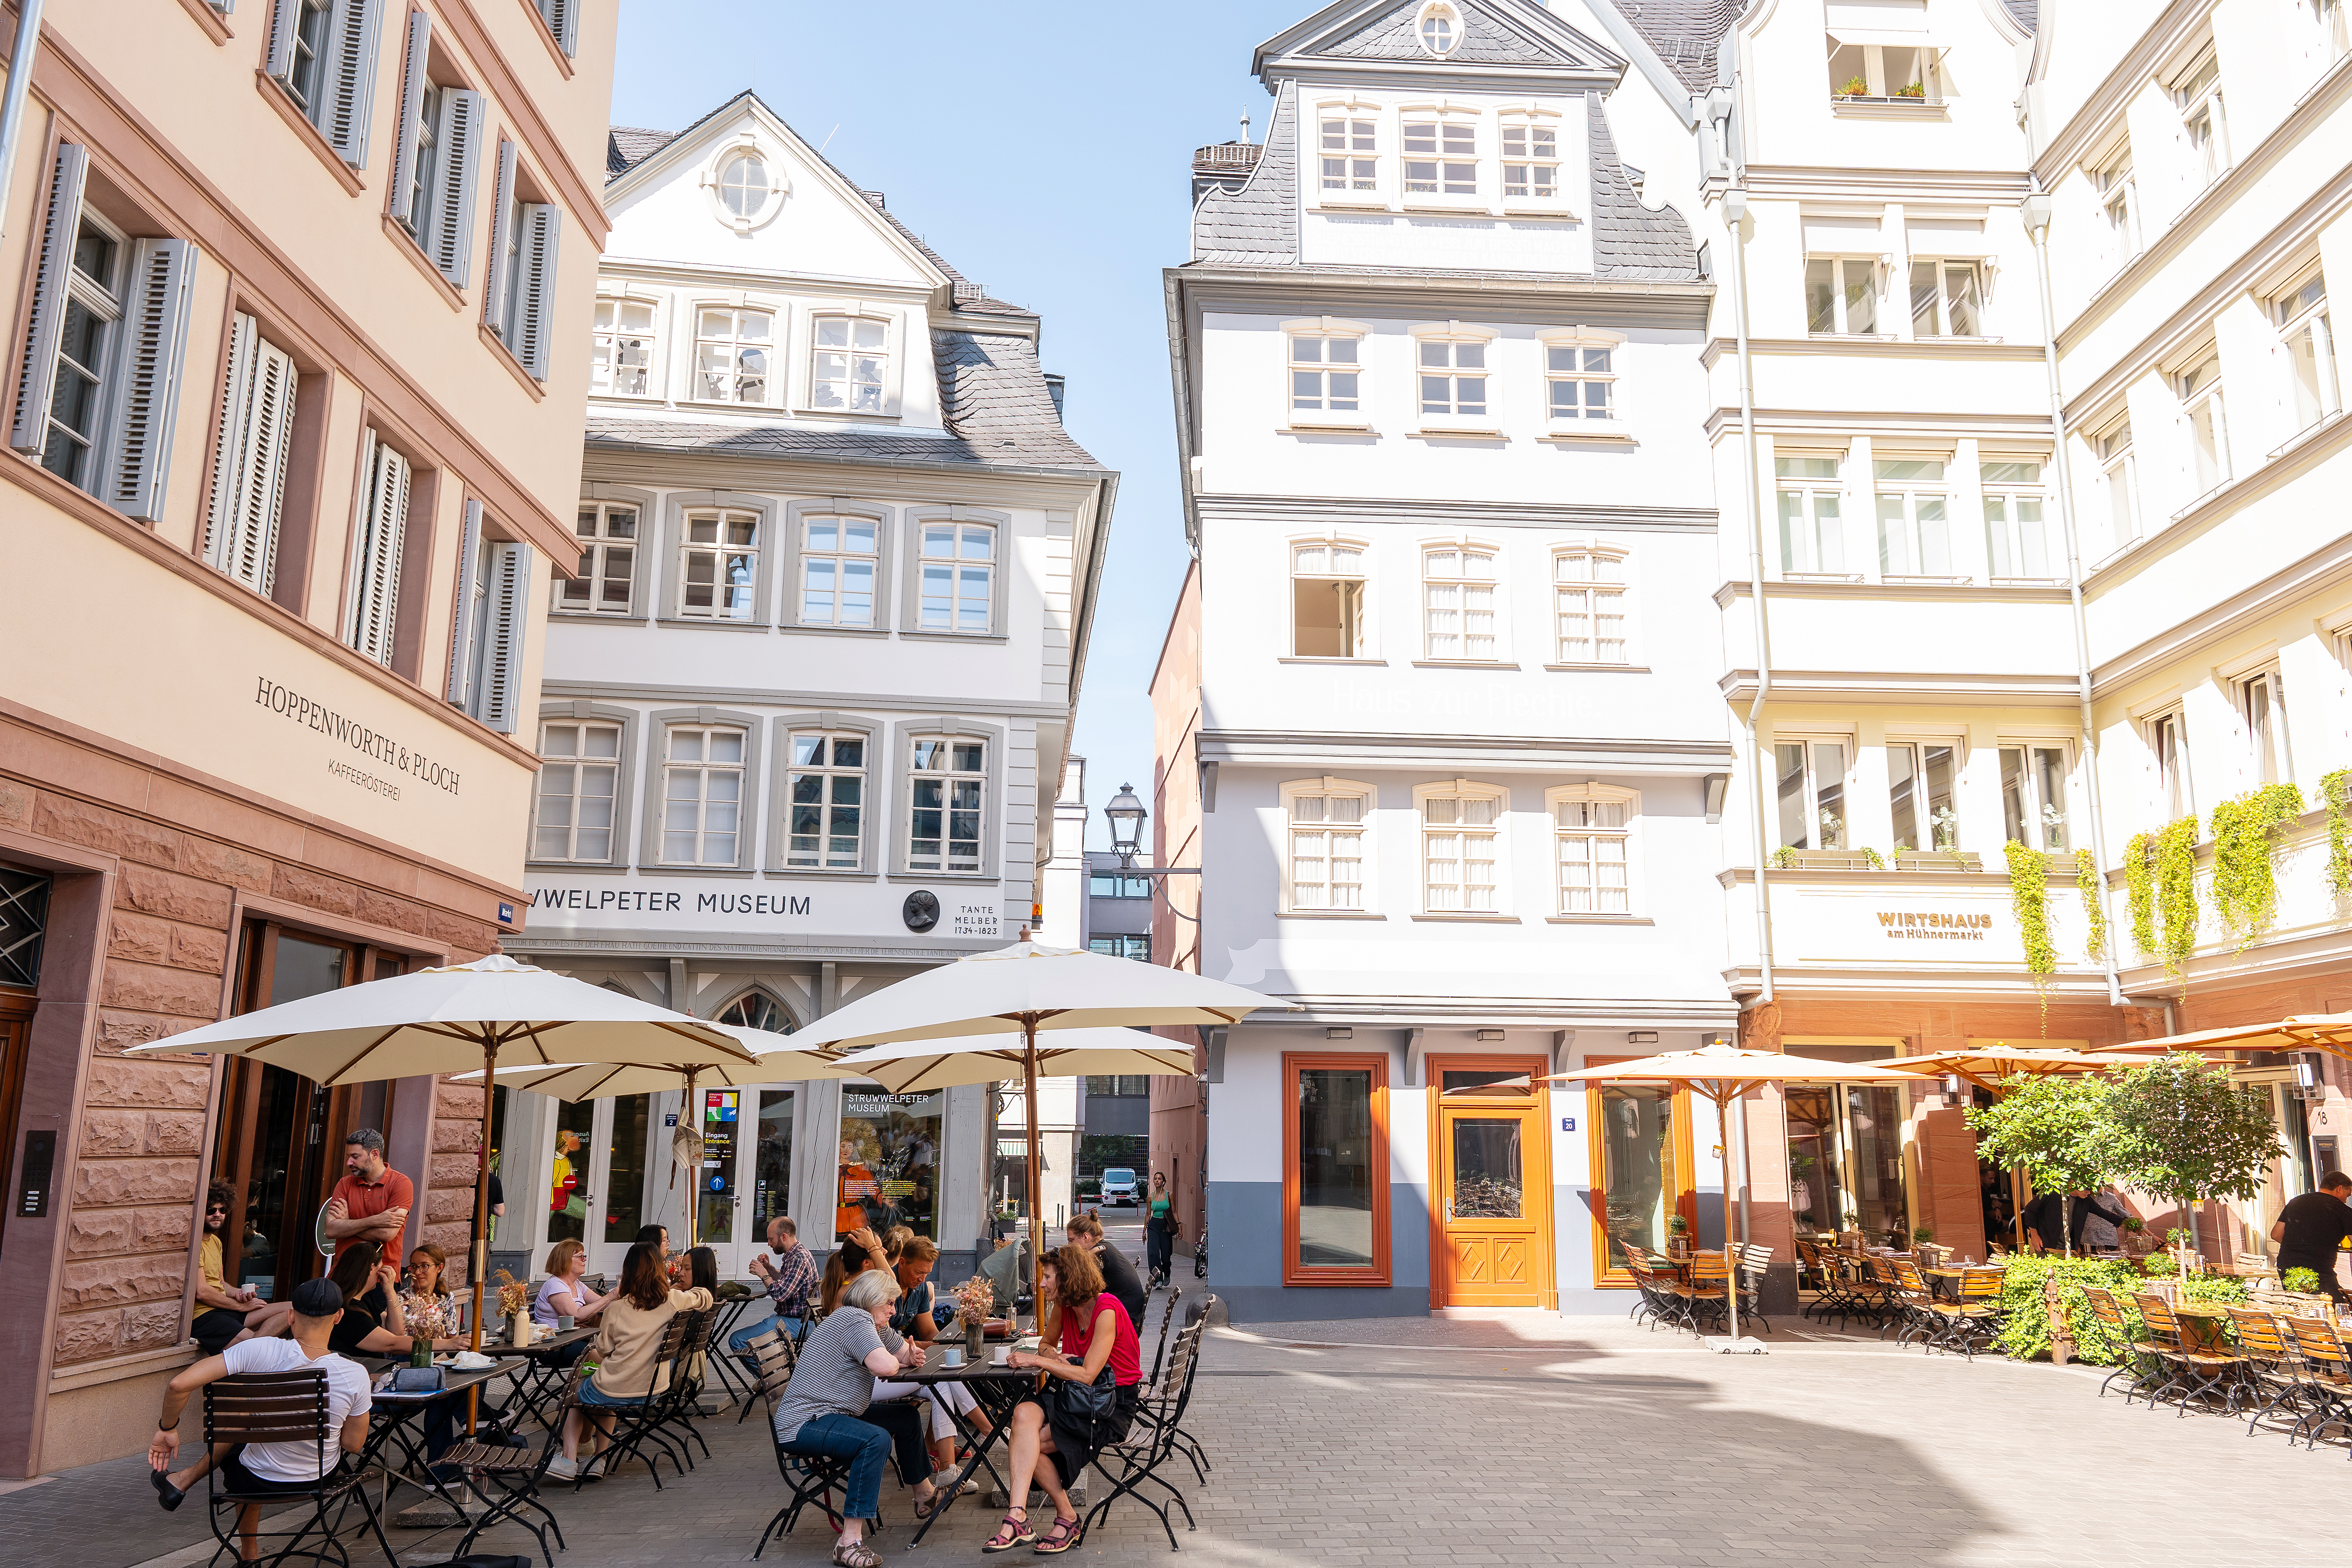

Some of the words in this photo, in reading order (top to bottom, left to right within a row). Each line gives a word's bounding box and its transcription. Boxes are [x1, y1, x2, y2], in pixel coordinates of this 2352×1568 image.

[1332, 679, 1412, 713] Haus
[1428, 690, 1478, 716] zur
[255, 676, 396, 766] HOPPENWORTH
[399, 747, 409, 772] &
[412, 753, 460, 796] PLOCH
[328, 759, 401, 802] KAFFEERÖSTEREI
[698, 893, 810, 915] MUSEUM
[502, 908, 512, 918] Markt
[1877, 912, 1992, 929] WIRTSHAUS
[1907, 929, 1984, 940] Hühnermarkt
[848, 1094, 929, 1103] STRUWWELPETER
[848, 1104, 889, 1112] MUSEUM
[2318, 1111, 2328, 1125] 18
